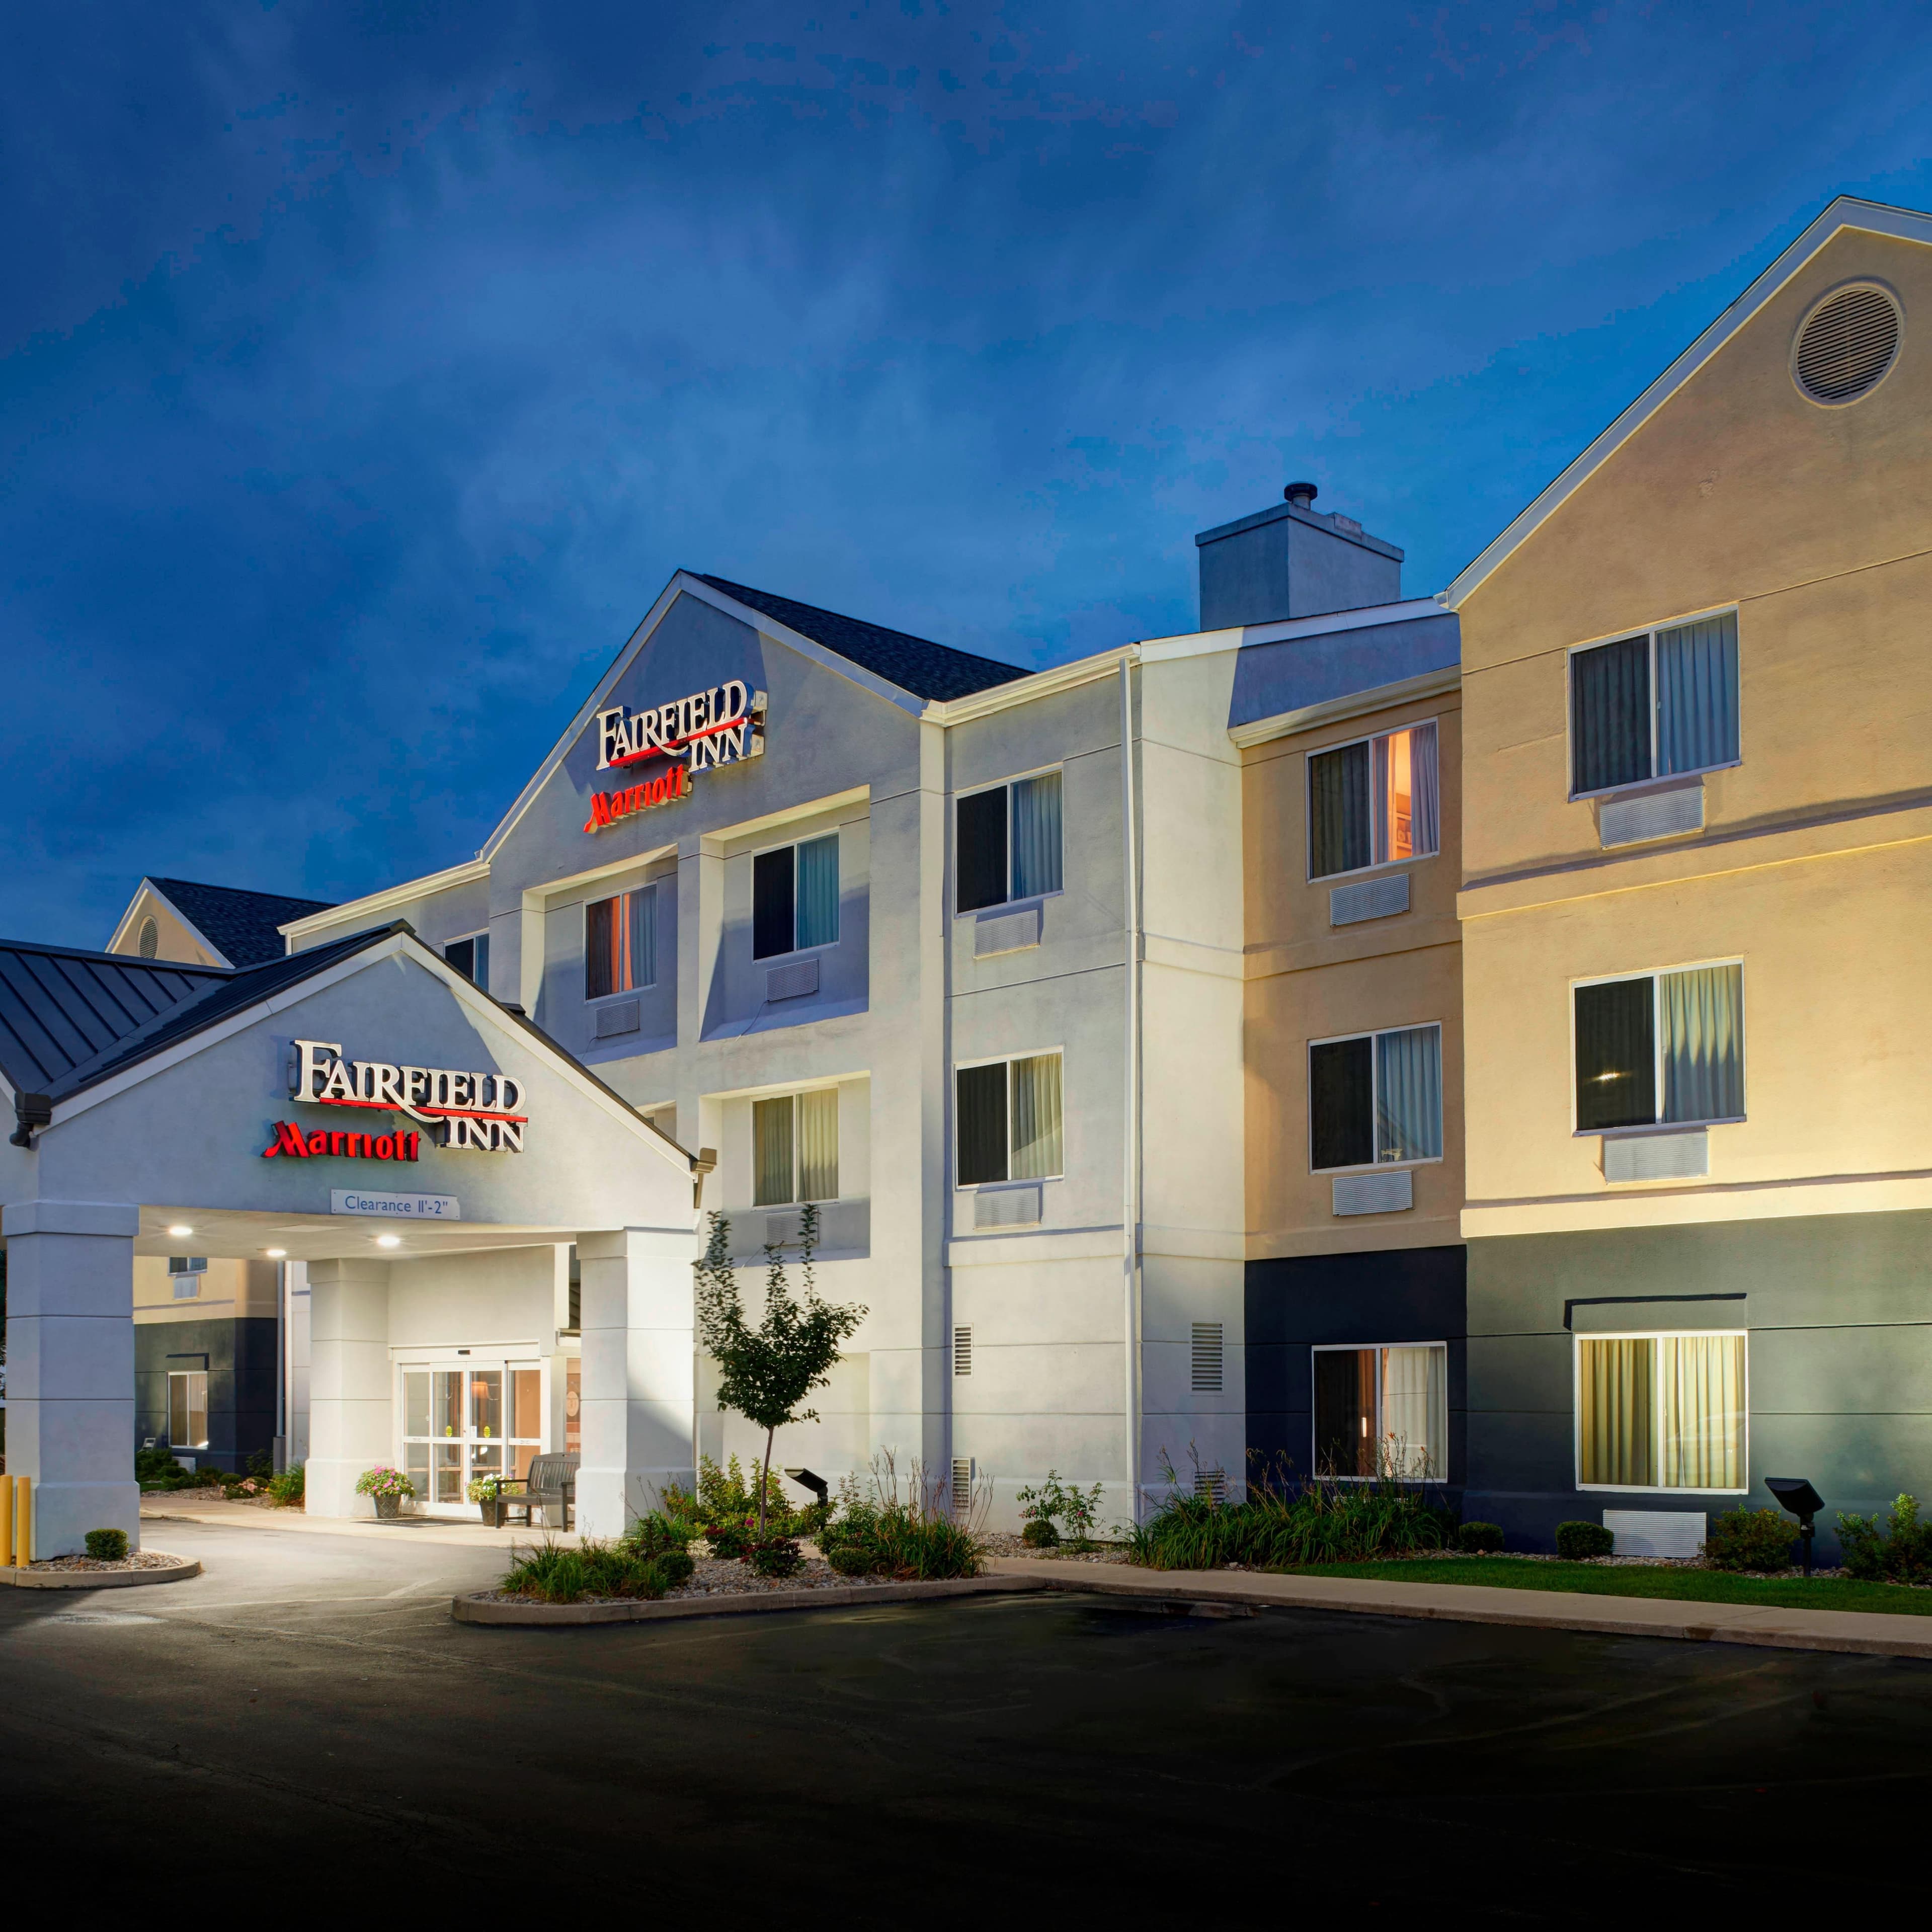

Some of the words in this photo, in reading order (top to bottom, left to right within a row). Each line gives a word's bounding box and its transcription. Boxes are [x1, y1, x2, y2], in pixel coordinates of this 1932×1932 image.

[596, 680, 748, 771] FAIRFIELD
[688, 723, 748, 773] INN
[584, 764, 684, 833] Marriott
[293, 1039, 527, 1123] FAIRFIELD
[262, 1120, 421, 1162] Marriott
[446, 1116, 527, 1153] INN
[345, 1195, 411, 1213] Clearance
